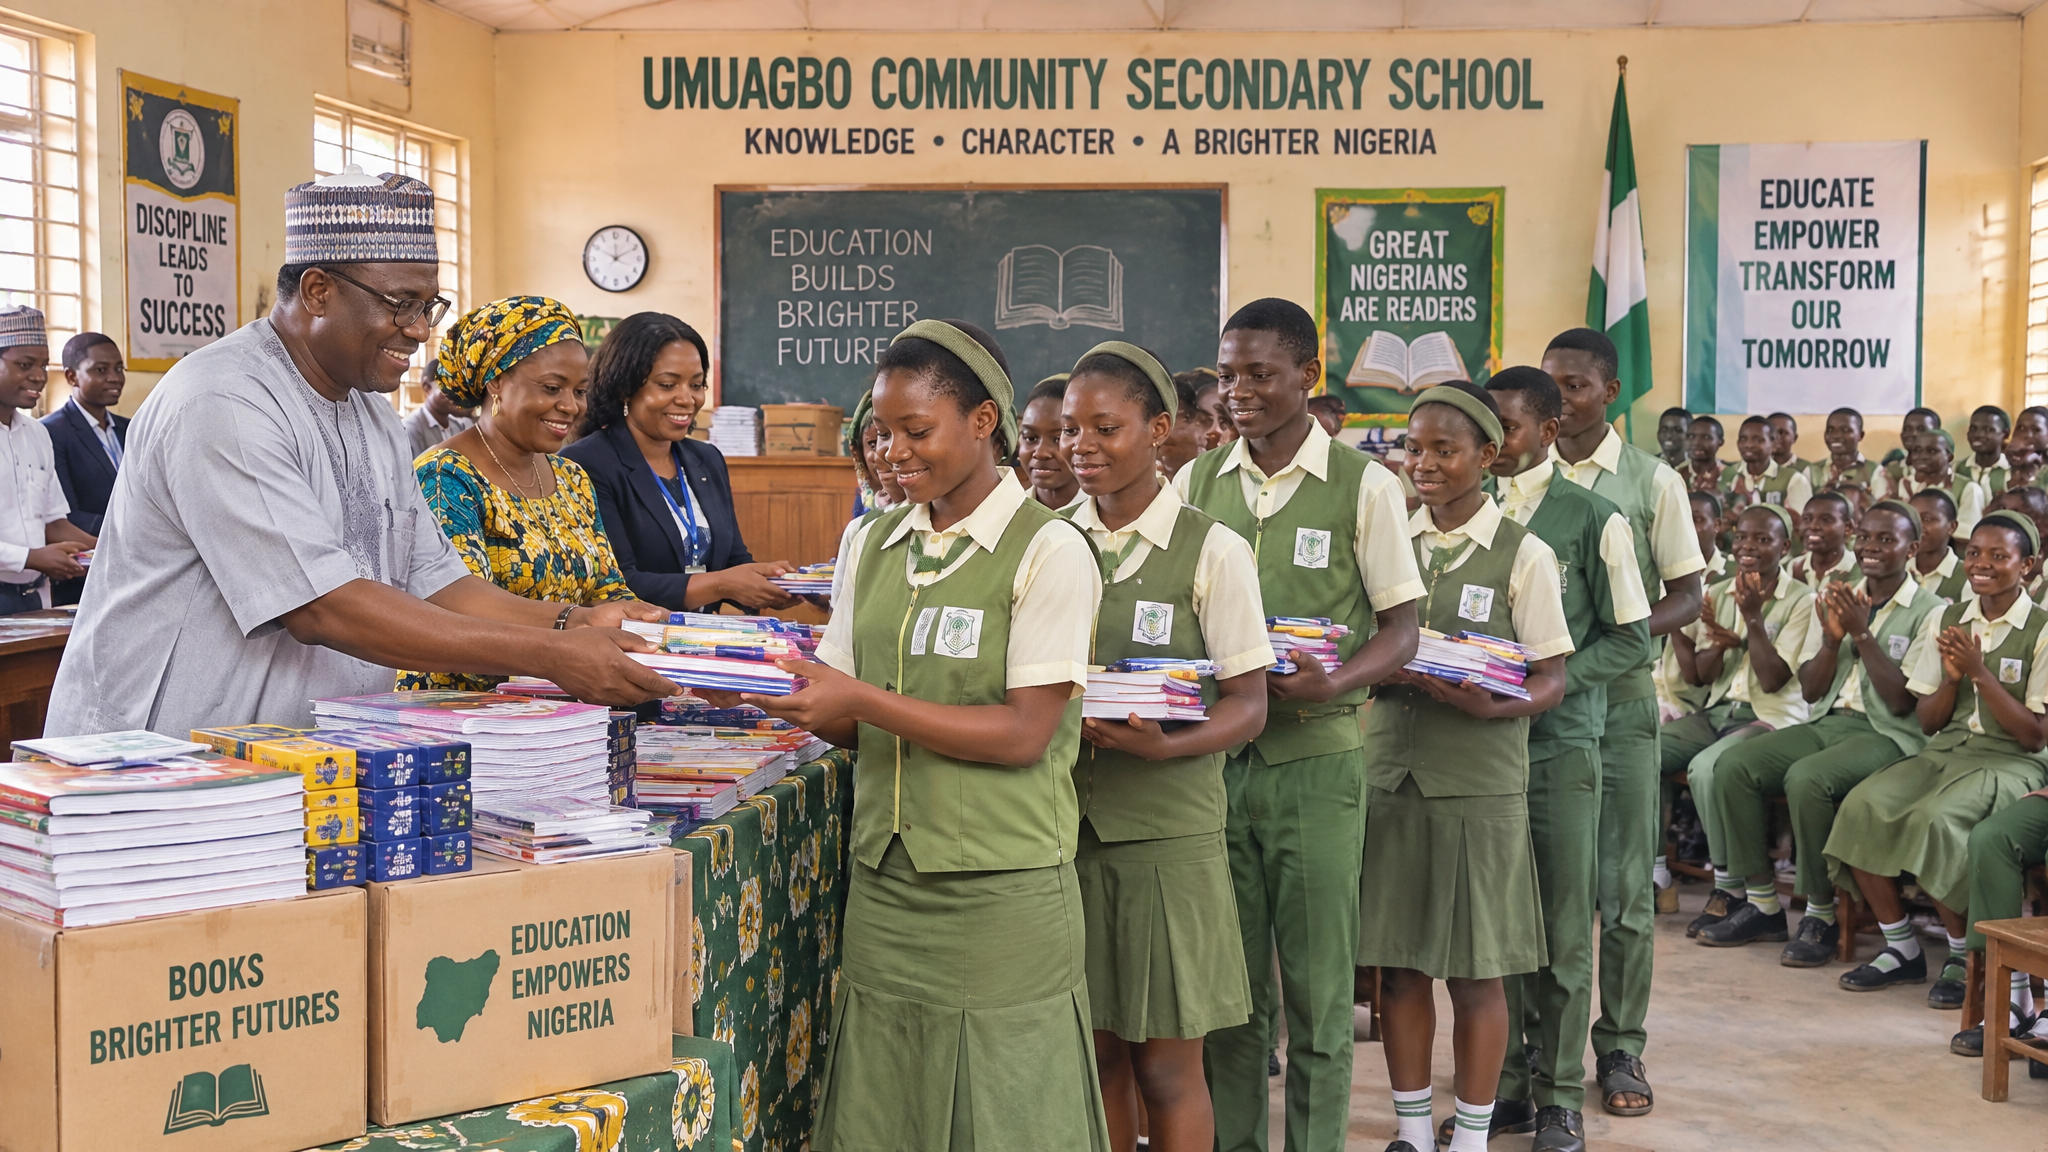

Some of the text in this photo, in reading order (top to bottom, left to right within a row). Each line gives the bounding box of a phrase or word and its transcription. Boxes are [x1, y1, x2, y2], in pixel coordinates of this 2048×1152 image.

[644, 57, 1543, 110] UMUAGBO COMMUNITY SECONDARY SCHOOL
[745, 128, 1437, 155] KNOWLEDGE CHARACTER A BRIGHTER NIGERIA
[1760, 178, 1875, 209] EDUCATE
[136, 203, 228, 246] DISCIPLINE
[1754, 219, 1880, 250] EMPOWER
[158, 242, 208, 271] LEADS
[771, 229, 932, 257] EDUCATION
[1369, 230, 1446, 260] GREAT
[173, 273, 194, 297] TO
[791, 264, 896, 292] BUILDS
[1350, 263, 1468, 292] NIGERIANS
[1740, 259, 1896, 291] TRANSFORM
[140, 297, 226, 338] SUCCESS
[778, 300, 919, 329] BRIGHTER
[1340, 296, 1477, 322] ARE READERS
[1791, 300, 1842, 330] OUR
[778, 337, 889, 366] FUTURE
[1742, 338, 1891, 369] TOMORROW
[511, 909, 631, 955] EDUCATION
[168, 953, 264, 1001] BOOKS
[511, 952, 631, 1000] EMPOWERS
[90, 990, 340, 1064] BRIGHTER FUTURES
[527, 997, 615, 1040] NIGERIA
